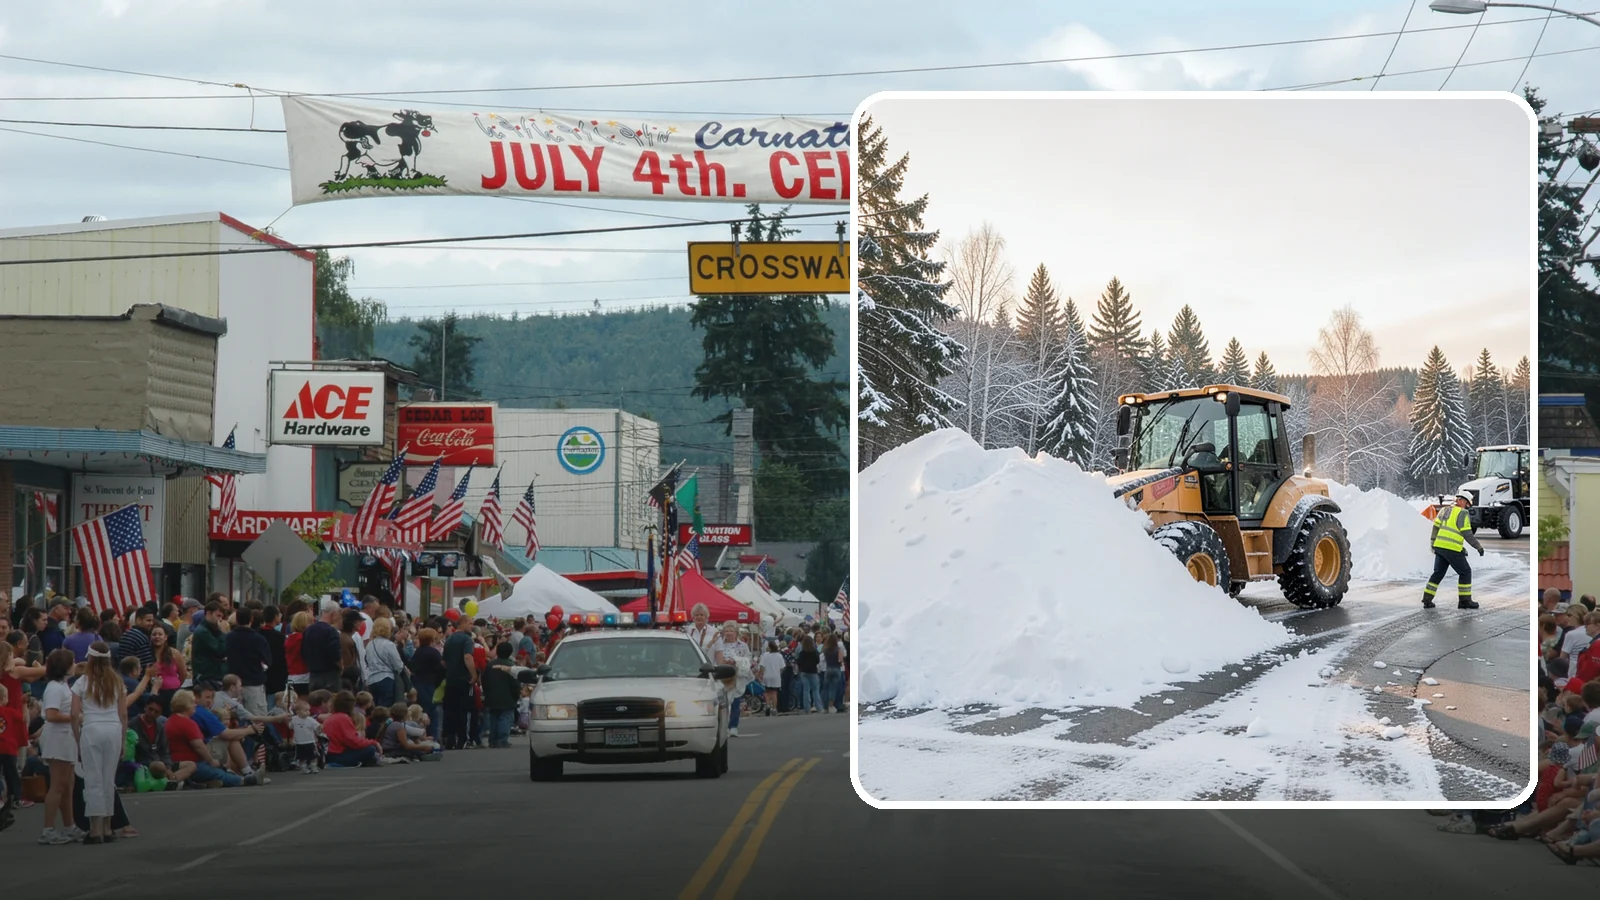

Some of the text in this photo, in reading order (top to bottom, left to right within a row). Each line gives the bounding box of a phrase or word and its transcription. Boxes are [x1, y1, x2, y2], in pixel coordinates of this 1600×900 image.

[695, 121, 850, 150] Carnat
[481, 141, 605, 192] JULY
[632, 149, 746, 198] 4th.
[697, 254, 850, 280] CROSSWA
[283, 380, 373, 420] ACE
[406, 409, 453, 421] CEDAR
[283, 421, 370, 436] Hardware
[416, 428, 477, 447] Coca-Cola
[354, 467, 386, 481] Simpl
[83, 484, 155, 495] St. Vincent de Paul
[81, 503, 154, 522] THT
[688, 526, 741, 535] CRNATION
[699, 535, 730, 543] GLASS
